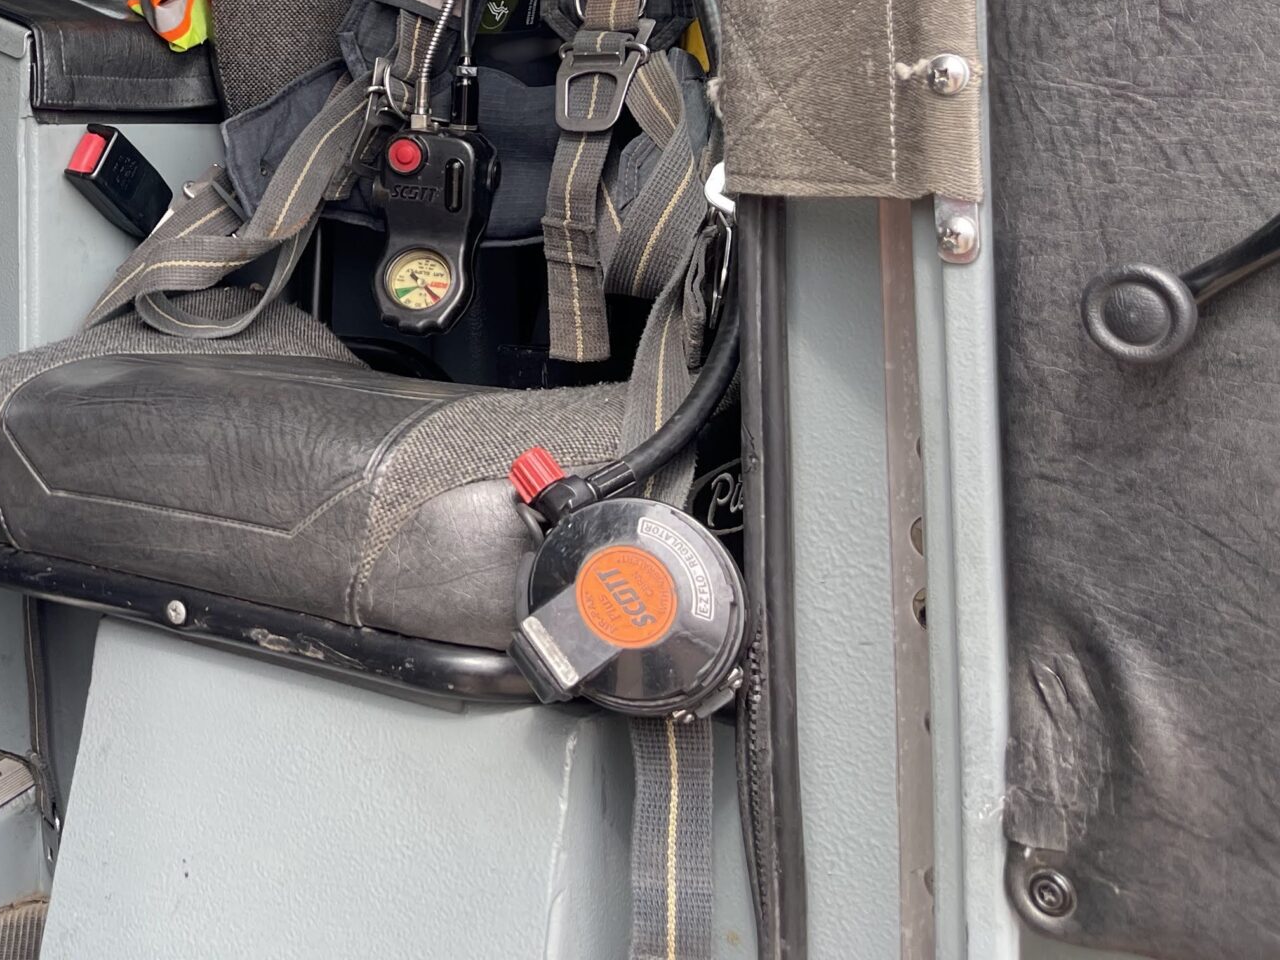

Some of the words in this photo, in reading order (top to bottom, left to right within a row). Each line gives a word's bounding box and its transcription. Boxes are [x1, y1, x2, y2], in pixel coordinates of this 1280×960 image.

[391, 184, 437, 202] SCOTT
[644, 523, 698, 569] REGULATOR
[597, 567, 658, 628] SCOTT
